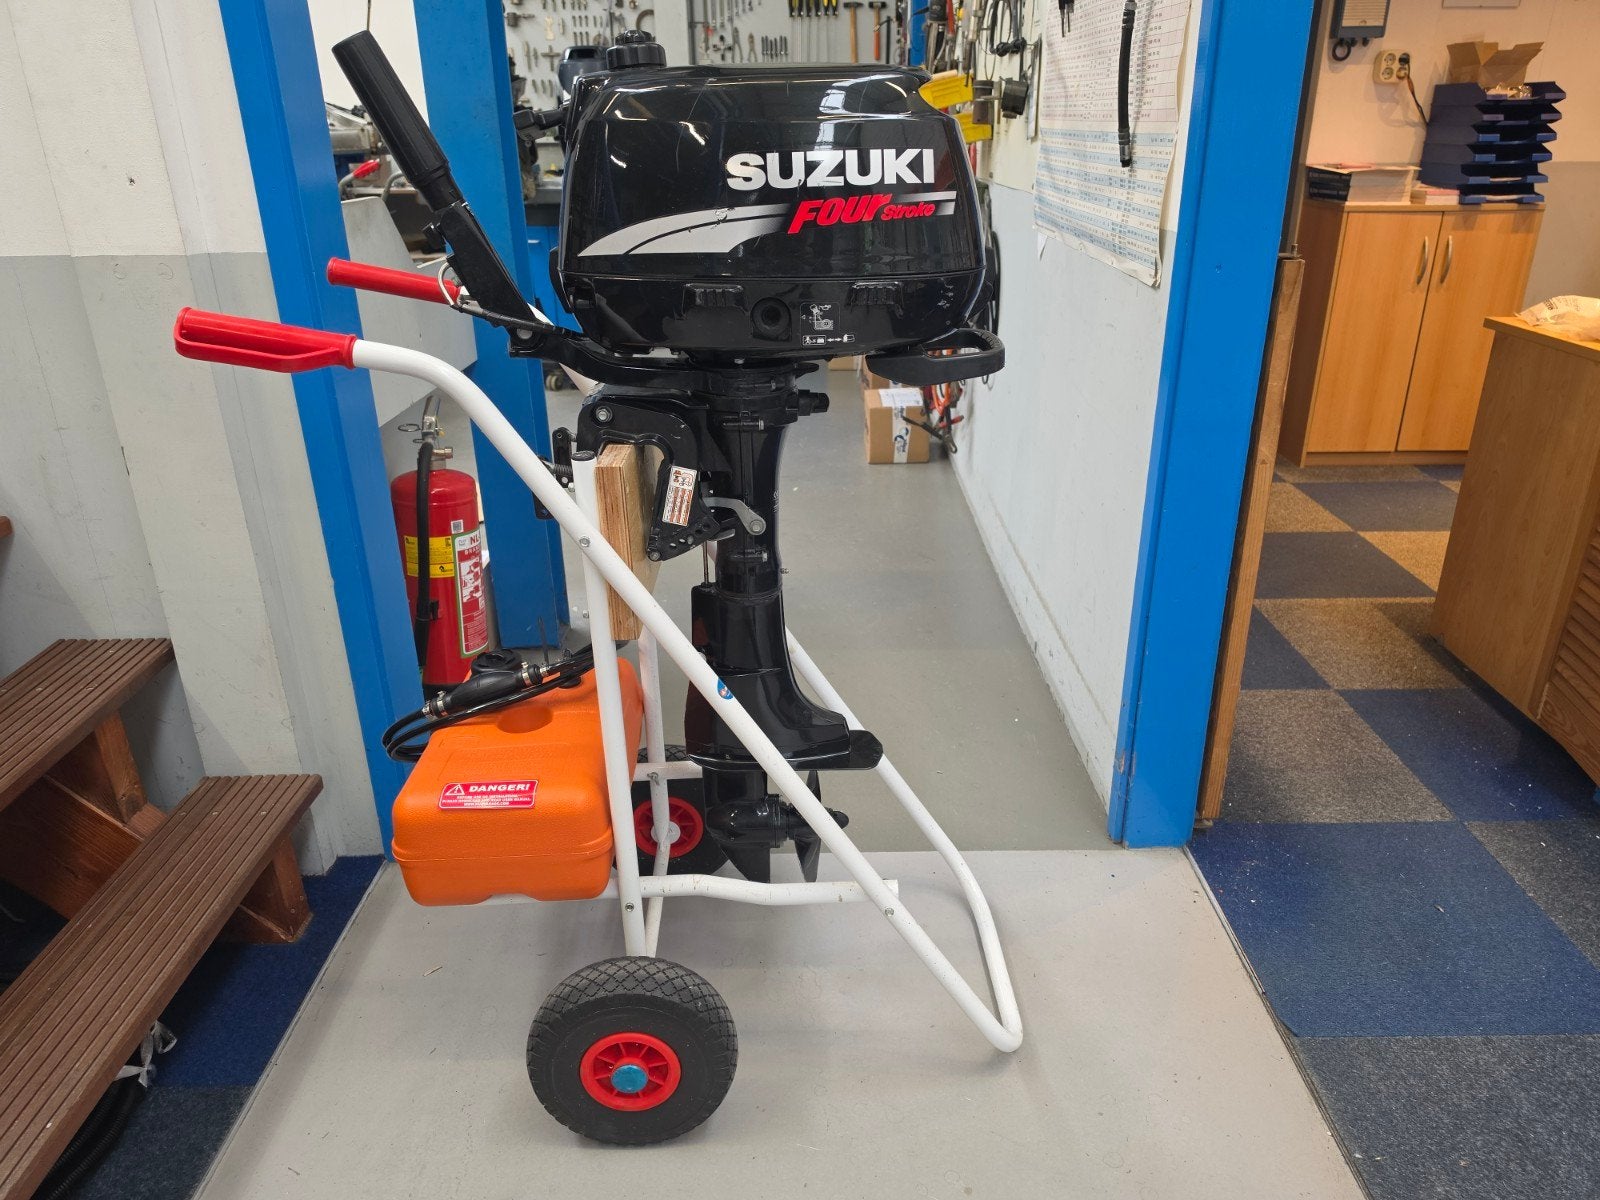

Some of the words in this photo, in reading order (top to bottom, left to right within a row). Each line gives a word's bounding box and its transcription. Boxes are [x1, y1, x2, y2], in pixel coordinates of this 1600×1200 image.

[726, 149, 935, 191] SUZUKI
[881, 202, 936, 221] Stroke
[469, 783, 530, 792] DANGER!
